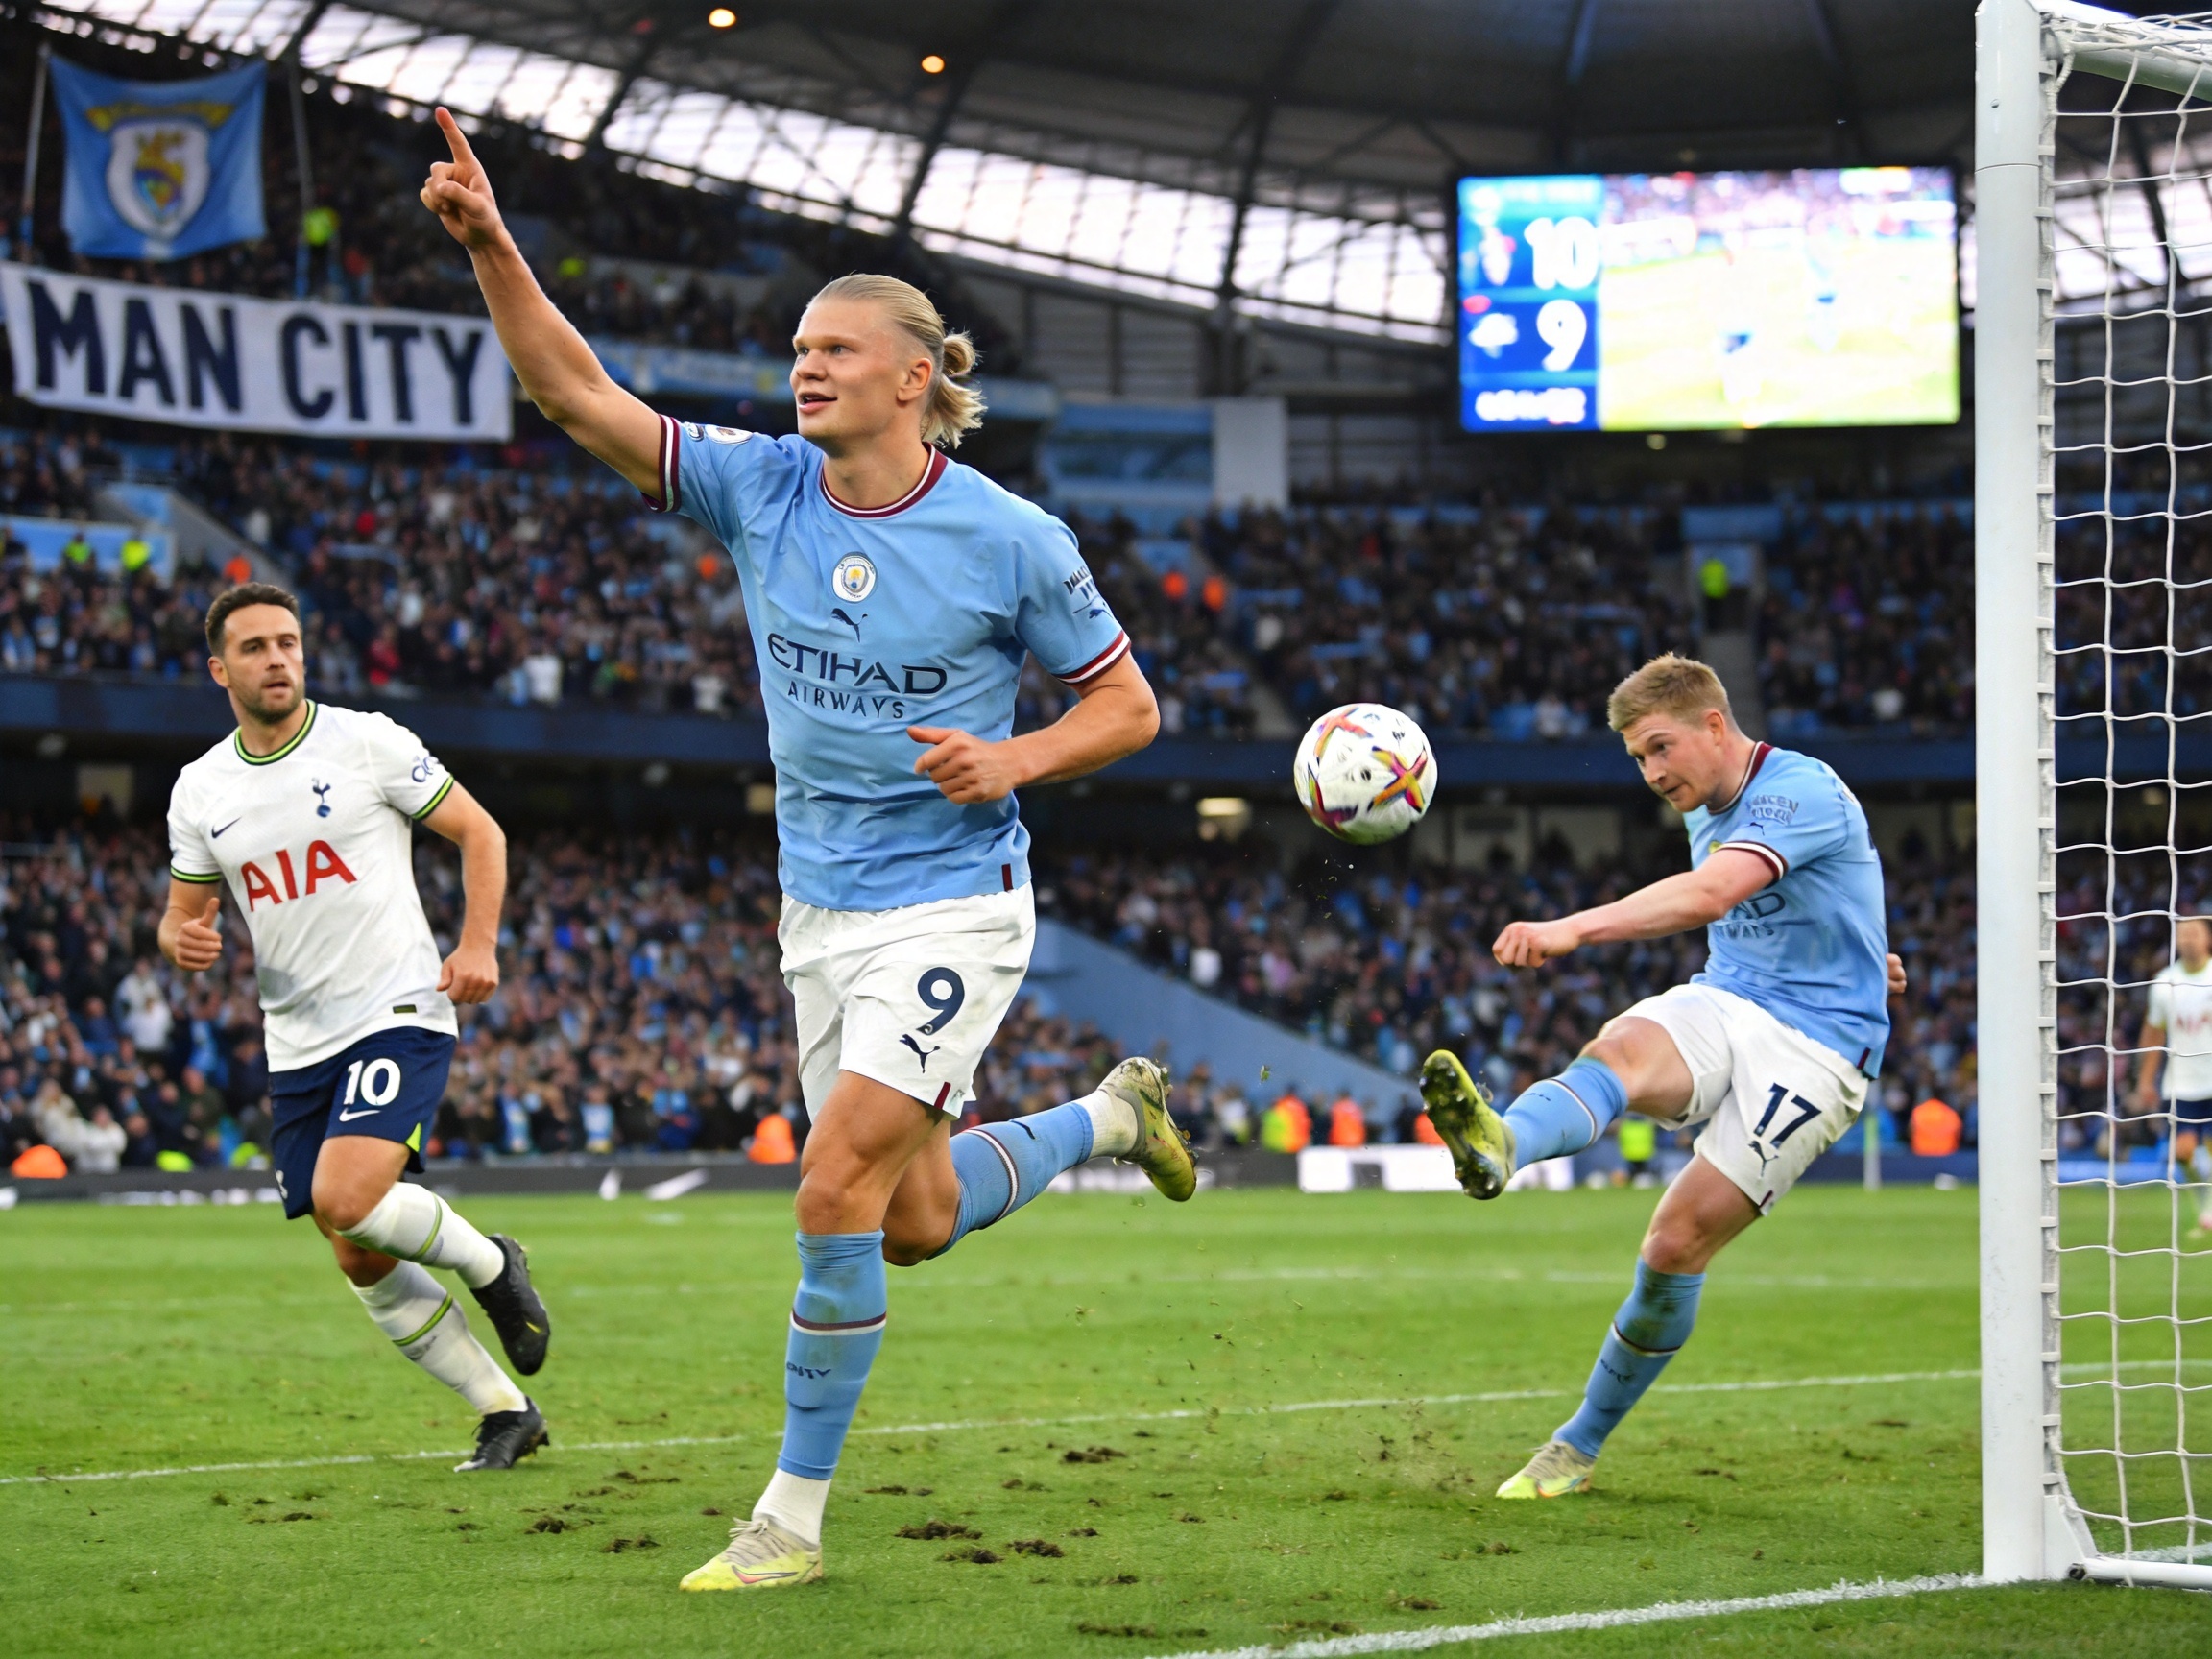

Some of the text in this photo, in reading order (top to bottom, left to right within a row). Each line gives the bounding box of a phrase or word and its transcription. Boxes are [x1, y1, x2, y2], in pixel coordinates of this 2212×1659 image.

[1524, 216, 1599, 290] 10
[24, 278, 485, 425] MAN CITY
[1536, 299, 1588, 372] 9
[768, 633, 947, 694] ETIHAD
[787, 680, 905, 719] AIRWAYS
[240, 839, 357, 912] AIA
[917, 966, 965, 1035] 9
[343, 1057, 401, 1107] 10
[1753, 1082, 1822, 1149] 17
